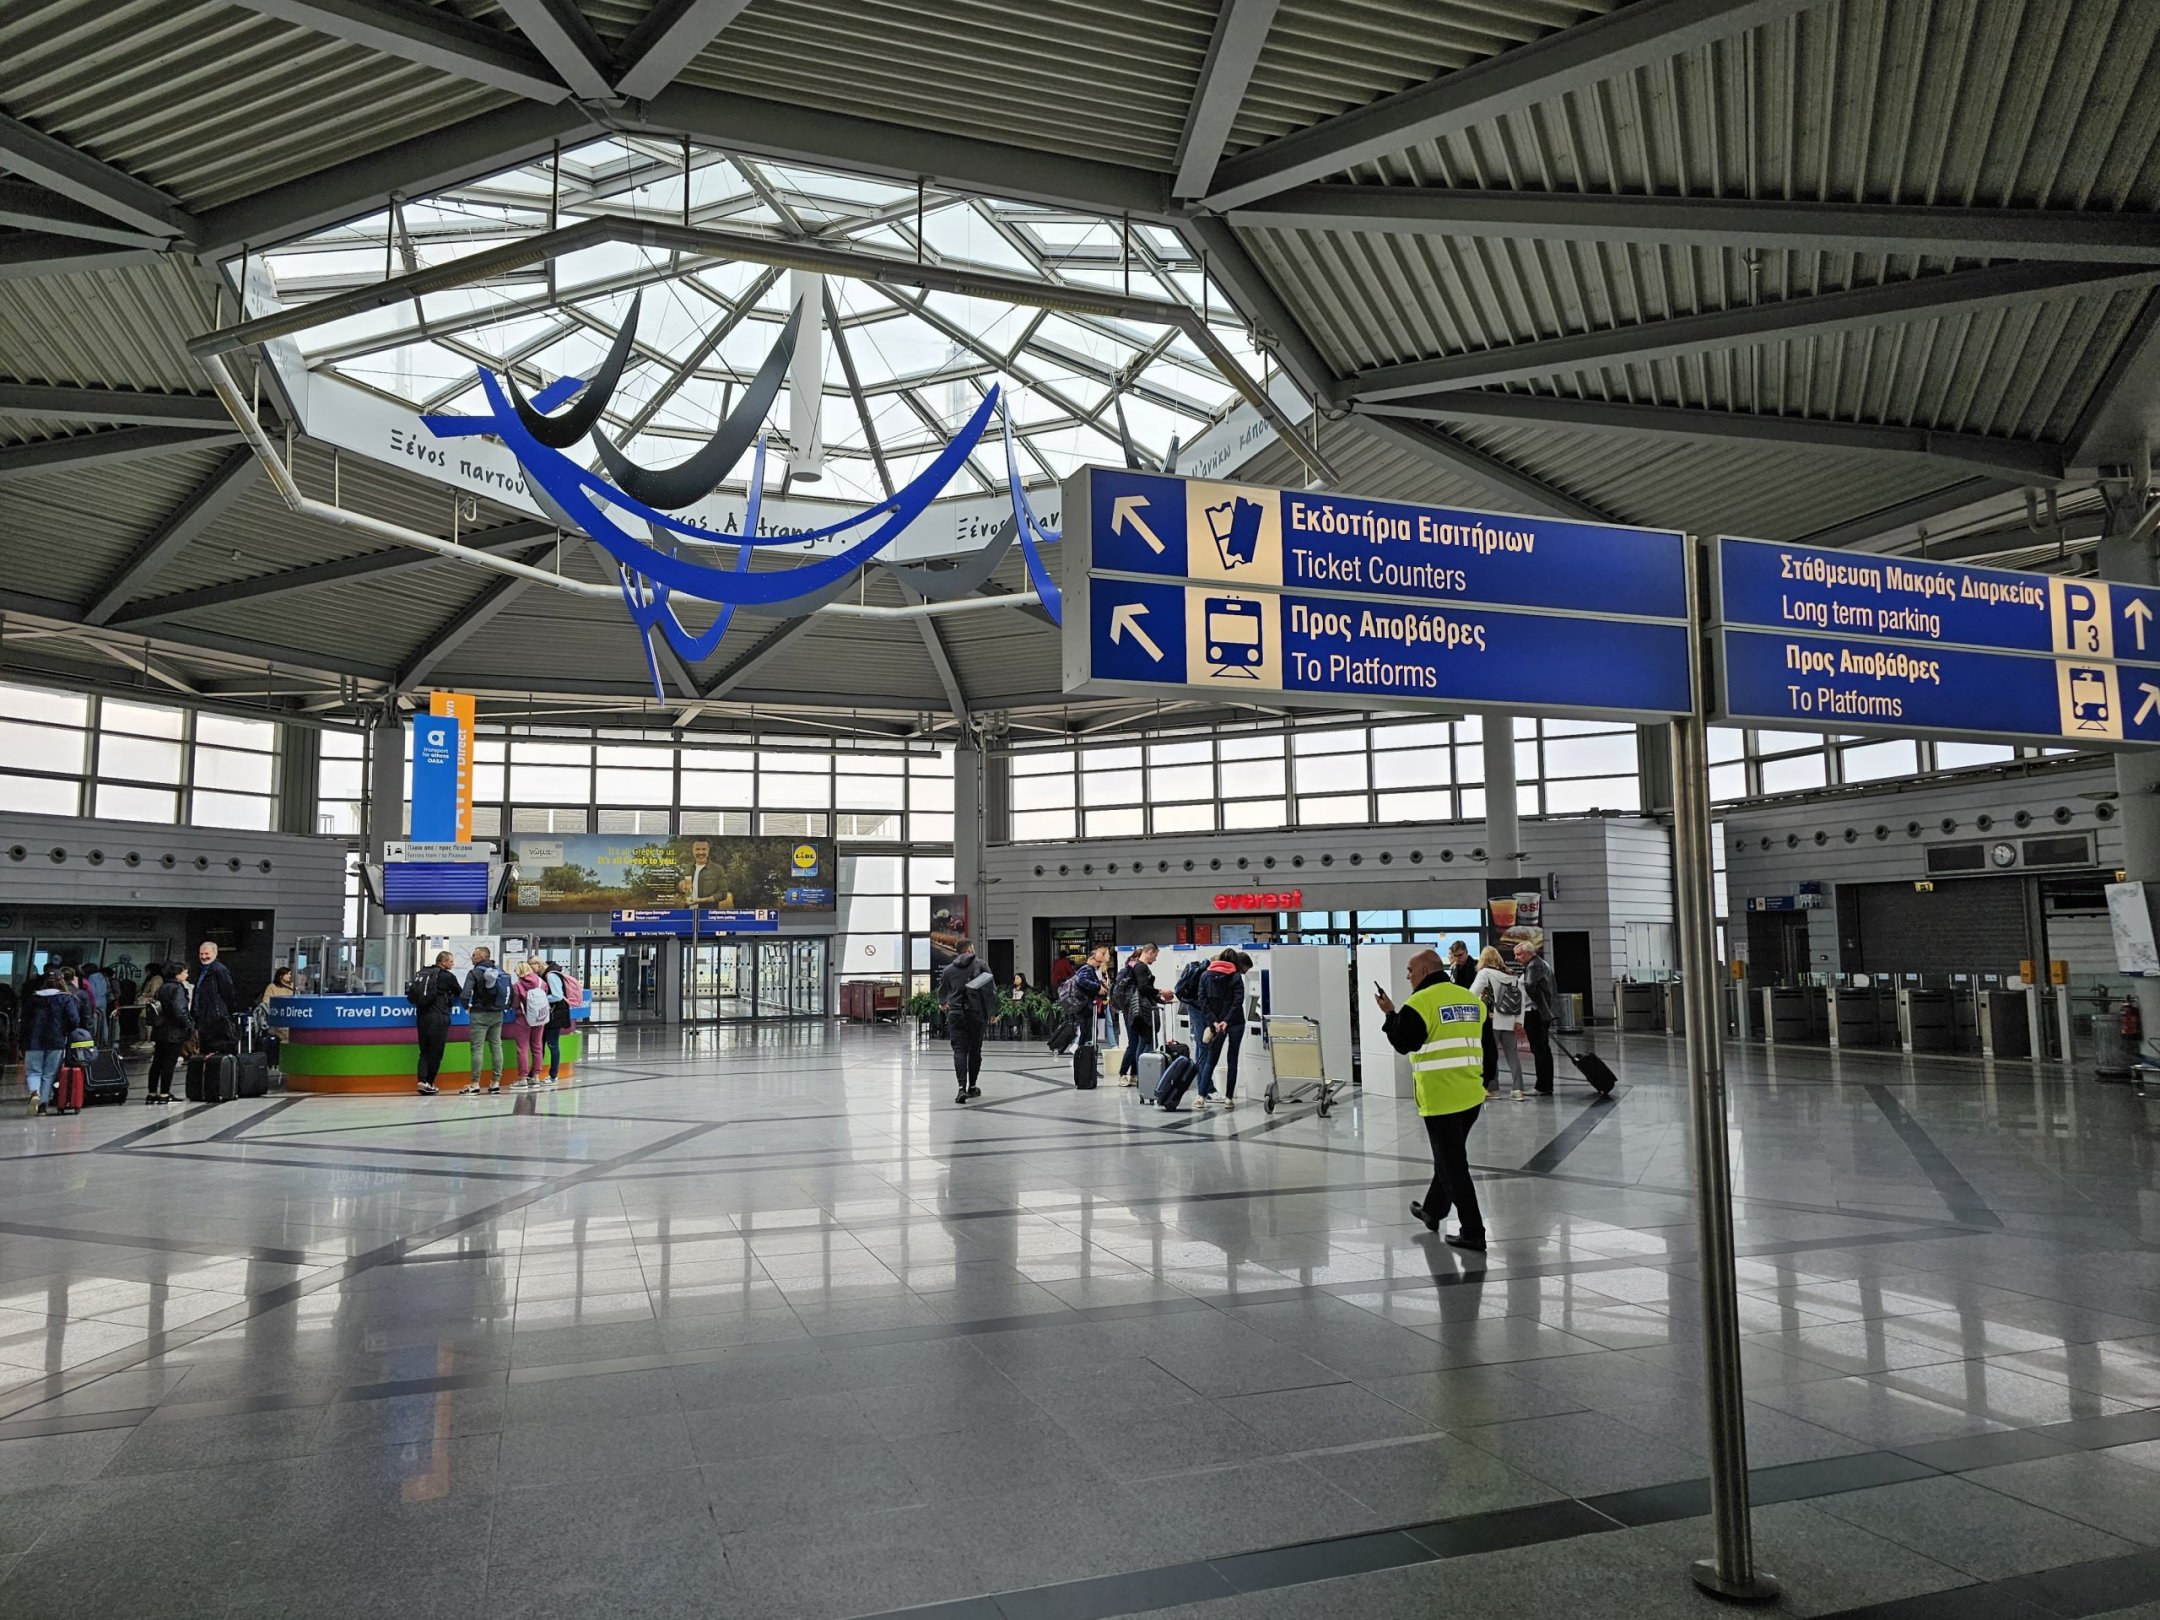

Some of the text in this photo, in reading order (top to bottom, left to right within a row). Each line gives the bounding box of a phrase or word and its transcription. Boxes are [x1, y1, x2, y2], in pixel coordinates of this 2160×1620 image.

[390, 429, 445, 467] Ξένος
[723, 512, 738, 533] A
[1292, 502, 1411, 544] Εκδοτήρια
[1292, 548, 1467, 592] Ticket Counters
[1781, 554, 2045, 611] Στάθμευση Μακράς Διαρκείας
[1292, 605, 1487, 652] Προς Αποβάθρες
[1783, 595, 1941, 639] Long term parking
[1292, 652, 1438, 689] To Platforms
[1786, 644, 1941, 685] Προς Αποβάθρες
[1787, 685, 1904, 718] To Platforms
[624, 855, 647, 864] Greek
[649, 856, 657, 864] to
[1214, 889, 1303, 910] everest
[286, 1006, 313, 1018] Direct
[335, 1005, 417, 1018] Travel Dow
